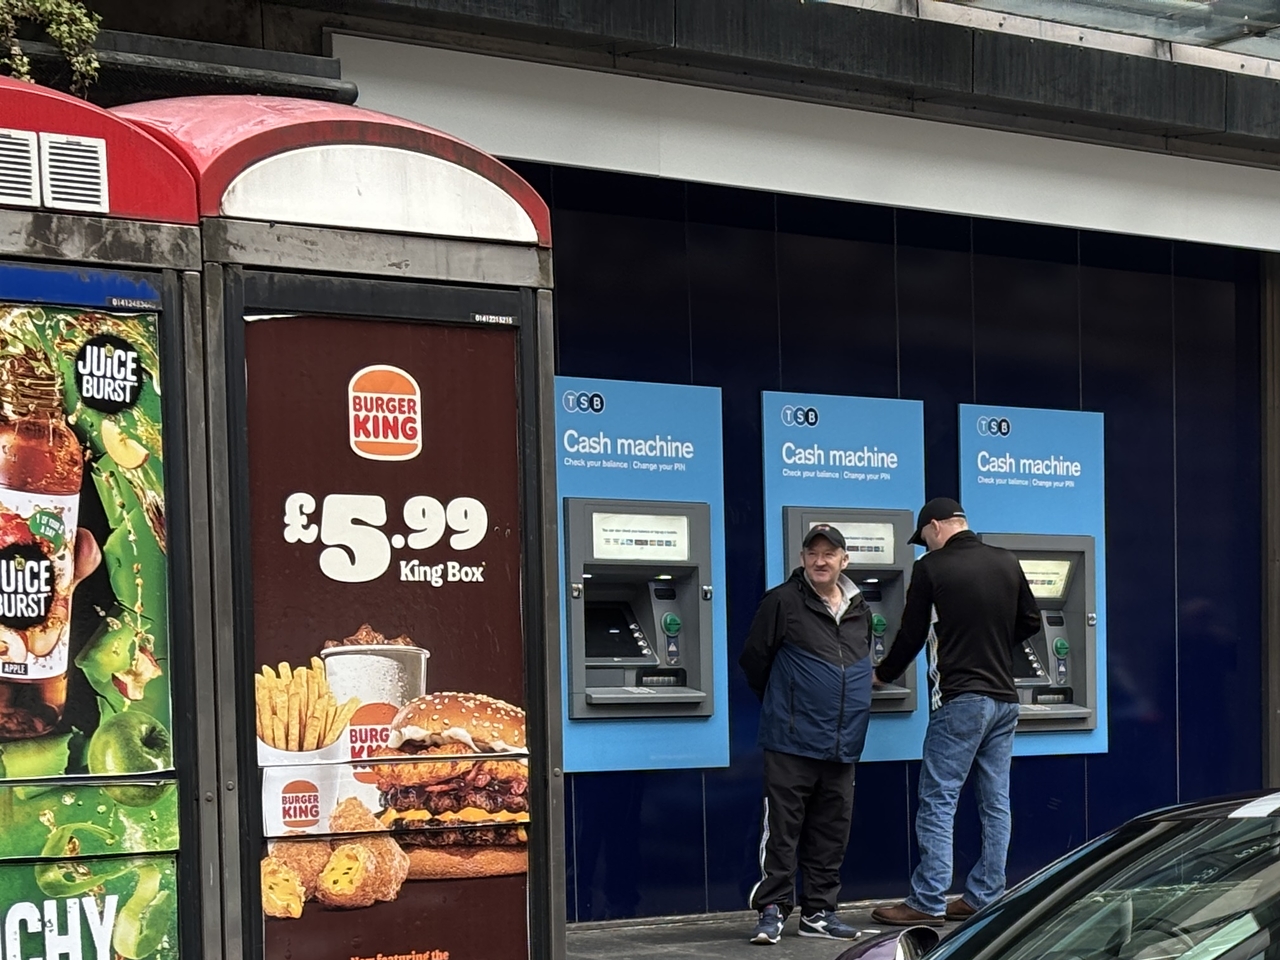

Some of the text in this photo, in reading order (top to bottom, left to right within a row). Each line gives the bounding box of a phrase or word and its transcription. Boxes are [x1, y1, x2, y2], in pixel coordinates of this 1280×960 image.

[82, 378, 132, 404] BURST
[352, 396, 417, 415] BURGER
[353, 414, 418, 441] KING
[563, 429, 694, 459] Cash machine
[782, 442, 898, 468] Cash machine
[563, 457, 586, 467] Check
[602, 460, 628, 469] balance
[632, 461, 658, 471] Change
[977, 451, 1081, 476] Cash machine
[284, 492, 488, 583] £5.99
[400, 560, 443, 588] King
[4, 662, 26, 675] APPLE
[350, 728, 390, 744] BURG
[281, 794, 319, 805] BURGER
[282, 804, 320, 820] KING
